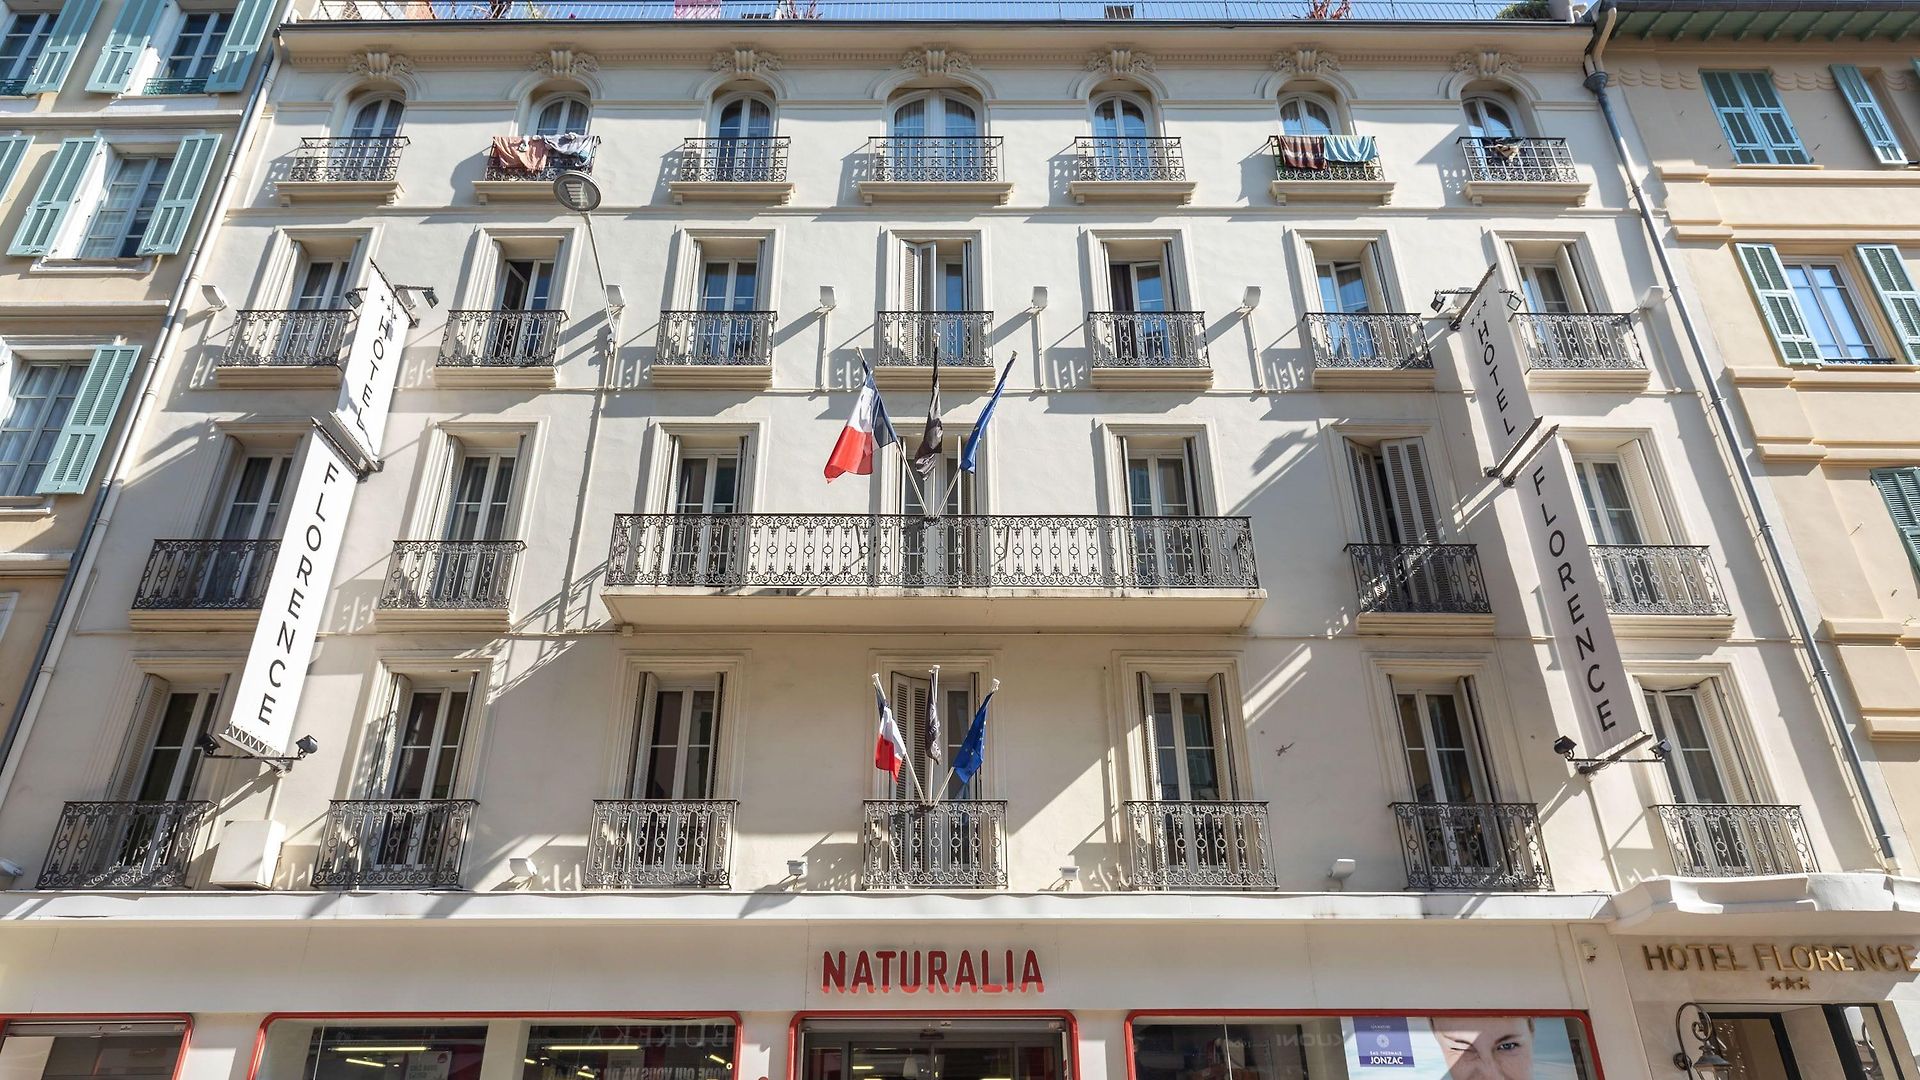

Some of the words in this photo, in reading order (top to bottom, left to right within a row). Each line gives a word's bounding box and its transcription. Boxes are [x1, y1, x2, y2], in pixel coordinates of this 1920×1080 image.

[356, 315, 390, 431] HÔTEL
[1478, 320, 1516, 437] HÔTEL
[258, 462, 339, 726] FLORENCE
[1532, 465, 1616, 732] FLORENCE
[822, 950, 1045, 994] NATURALIA
[1641, 943, 1748, 972] HOTEL
[1752, 943, 1920, 973] FLORENCE
[1370, 1056, 1404, 1065] JONZAC
